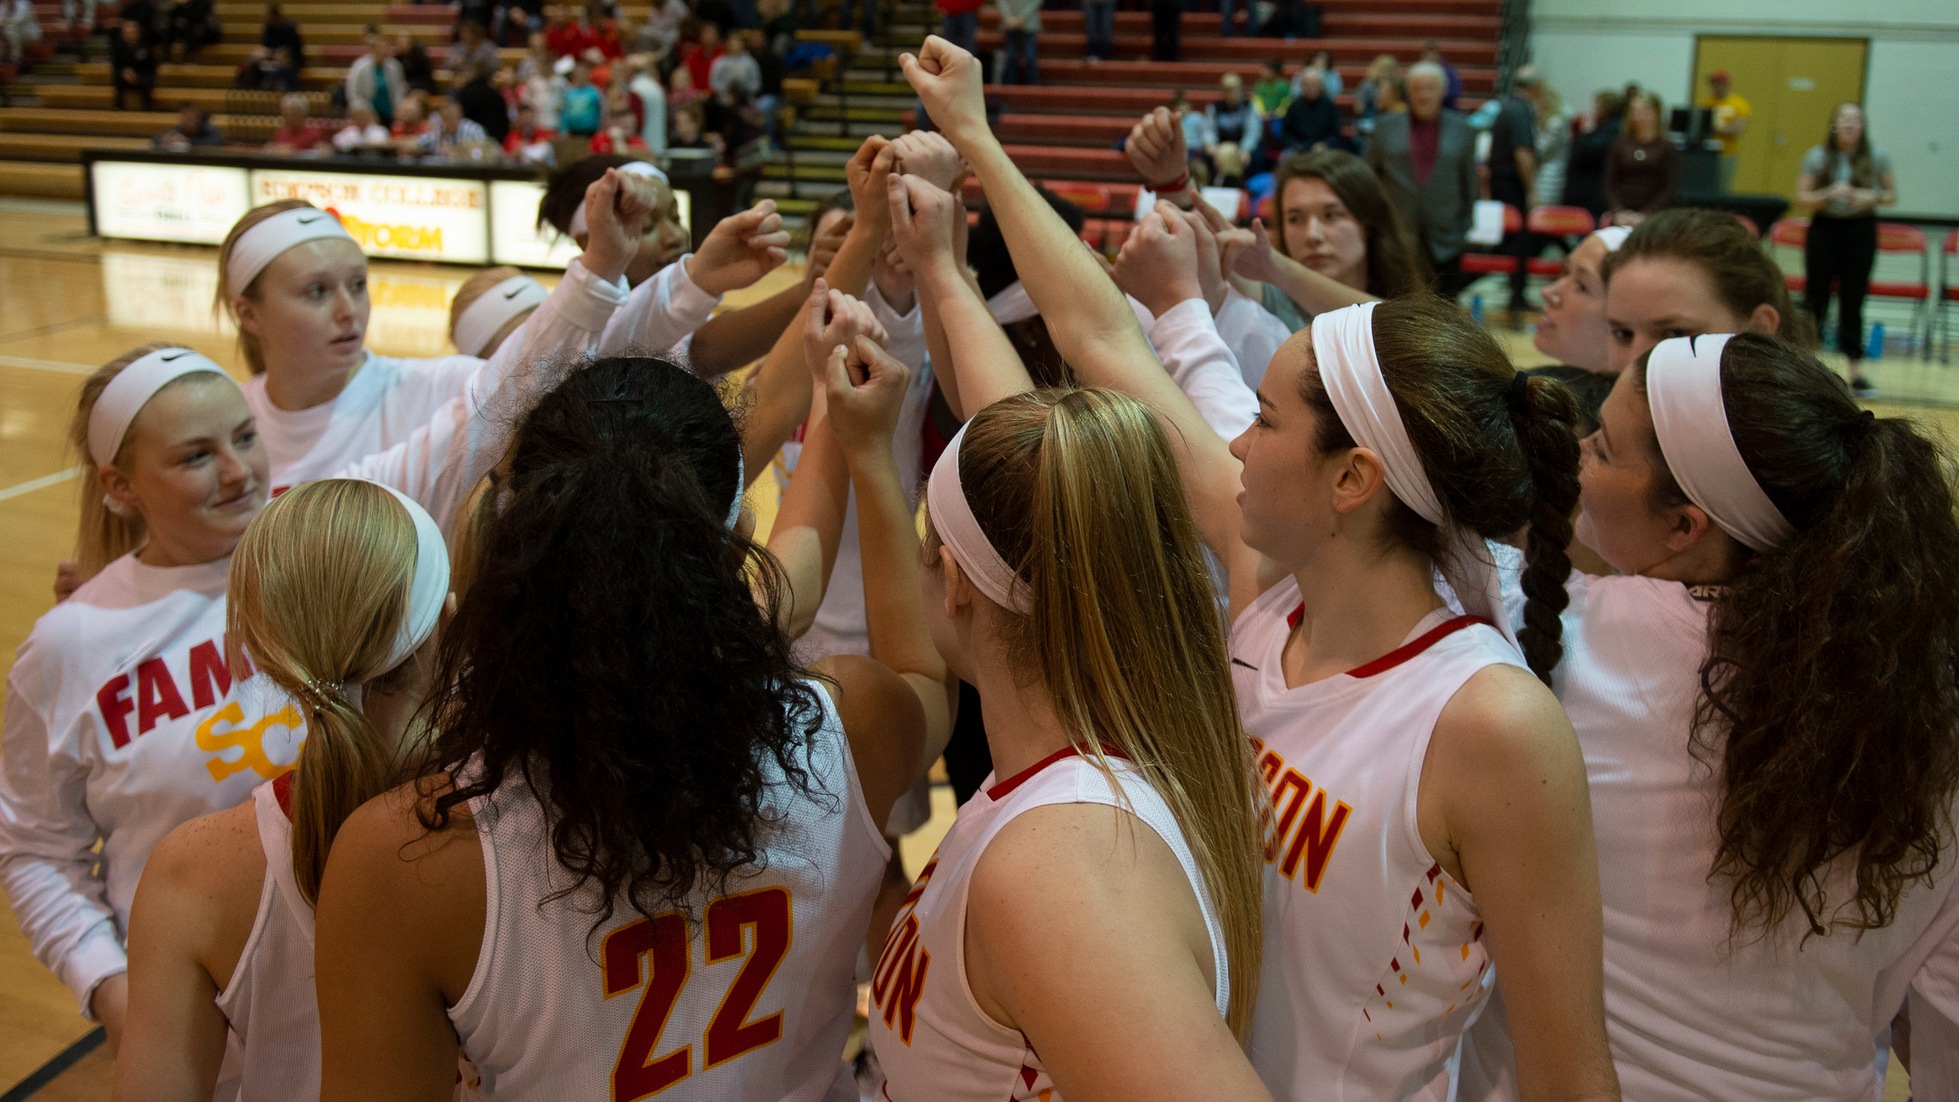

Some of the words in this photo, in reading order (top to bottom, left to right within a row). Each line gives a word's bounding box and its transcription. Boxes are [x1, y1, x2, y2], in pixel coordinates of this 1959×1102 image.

[371, 184, 482, 209] COLLEGE
[195, 700, 308, 783] SC
[602, 885, 792, 1102] 22
